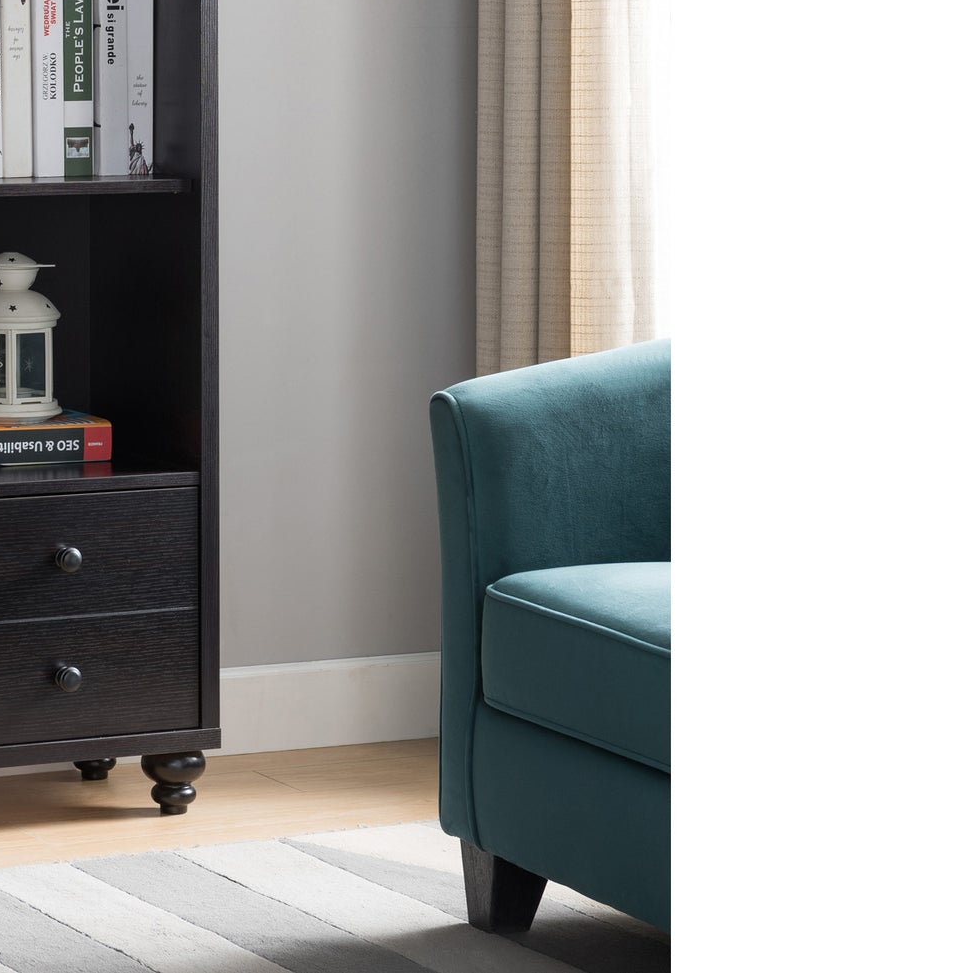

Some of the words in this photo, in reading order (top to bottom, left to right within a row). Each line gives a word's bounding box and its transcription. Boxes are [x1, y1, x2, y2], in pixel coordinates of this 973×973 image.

[107, 13, 116, 23] si
[105, 26, 117, 65] grande
[73, 26, 84, 93] PEOPLE'S
[45, 439, 55, 451] &
[57, 439, 80, 451] SEO
